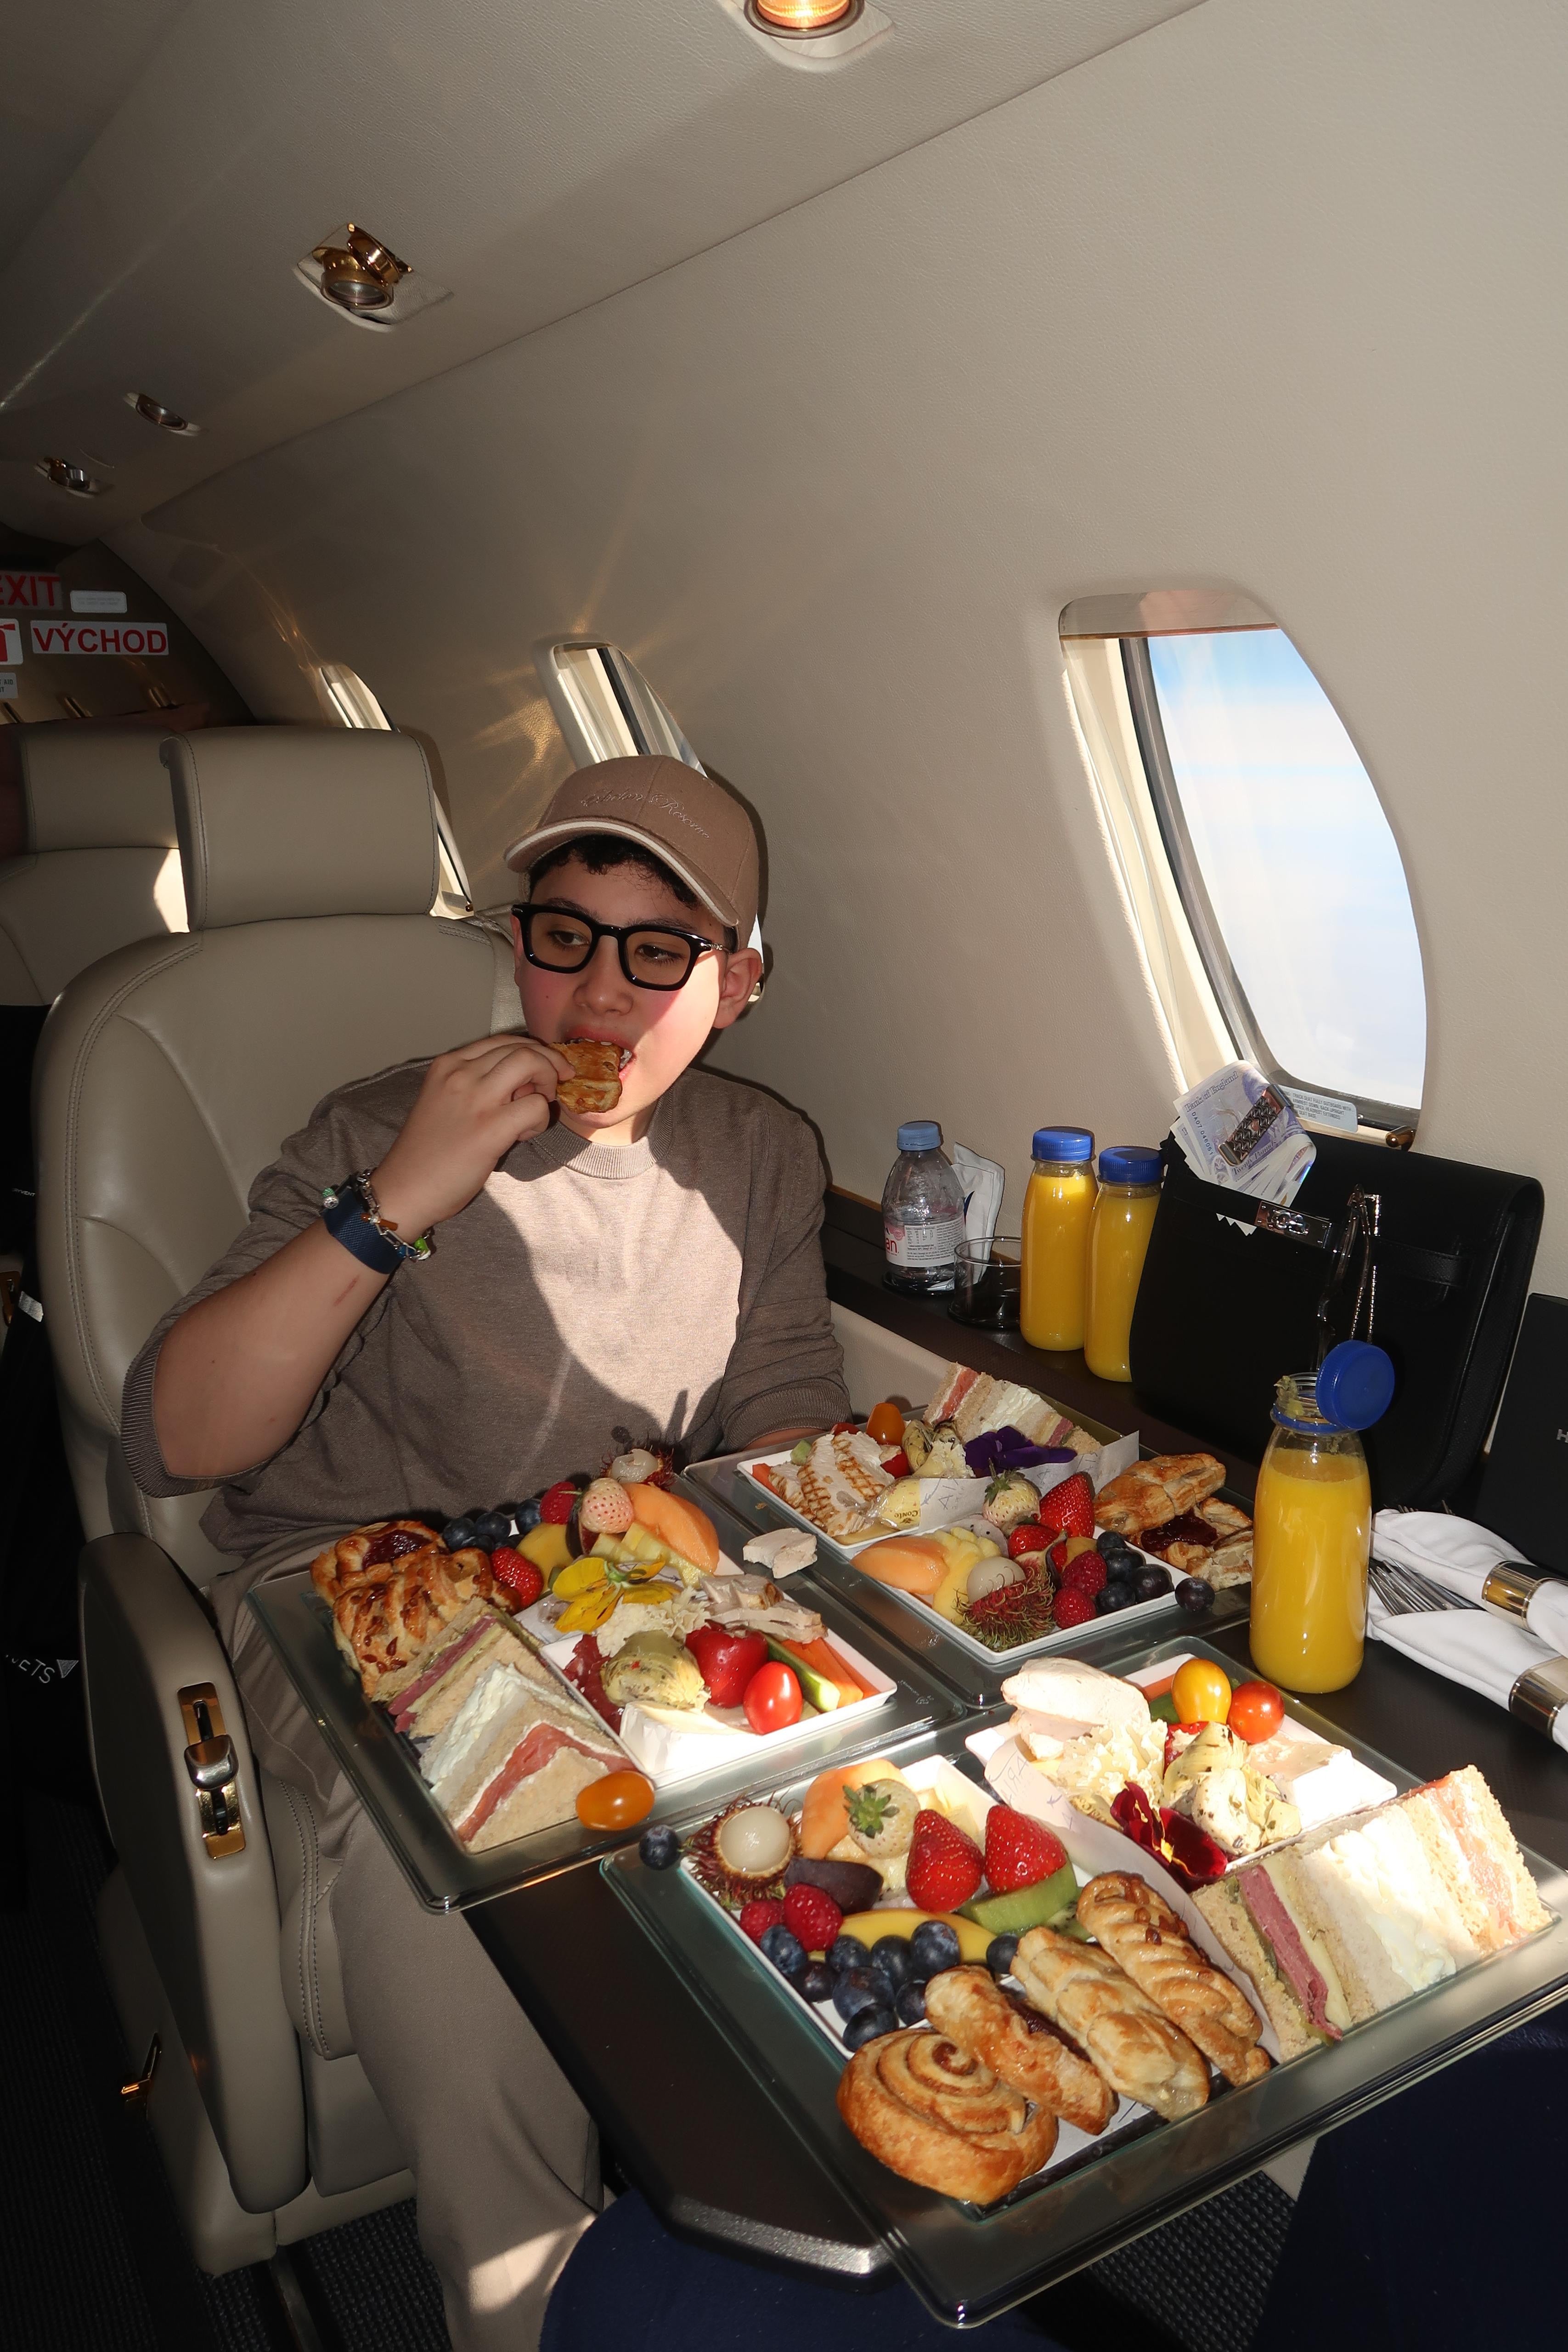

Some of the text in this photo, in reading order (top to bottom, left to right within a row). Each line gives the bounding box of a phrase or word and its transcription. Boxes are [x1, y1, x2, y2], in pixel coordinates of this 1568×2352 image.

[33, 622, 167, 653] VÝCHOD
[1184, 1071, 1239, 1113] Bank of England
[1232, 1140, 1276, 1176] Twenty Pounds
